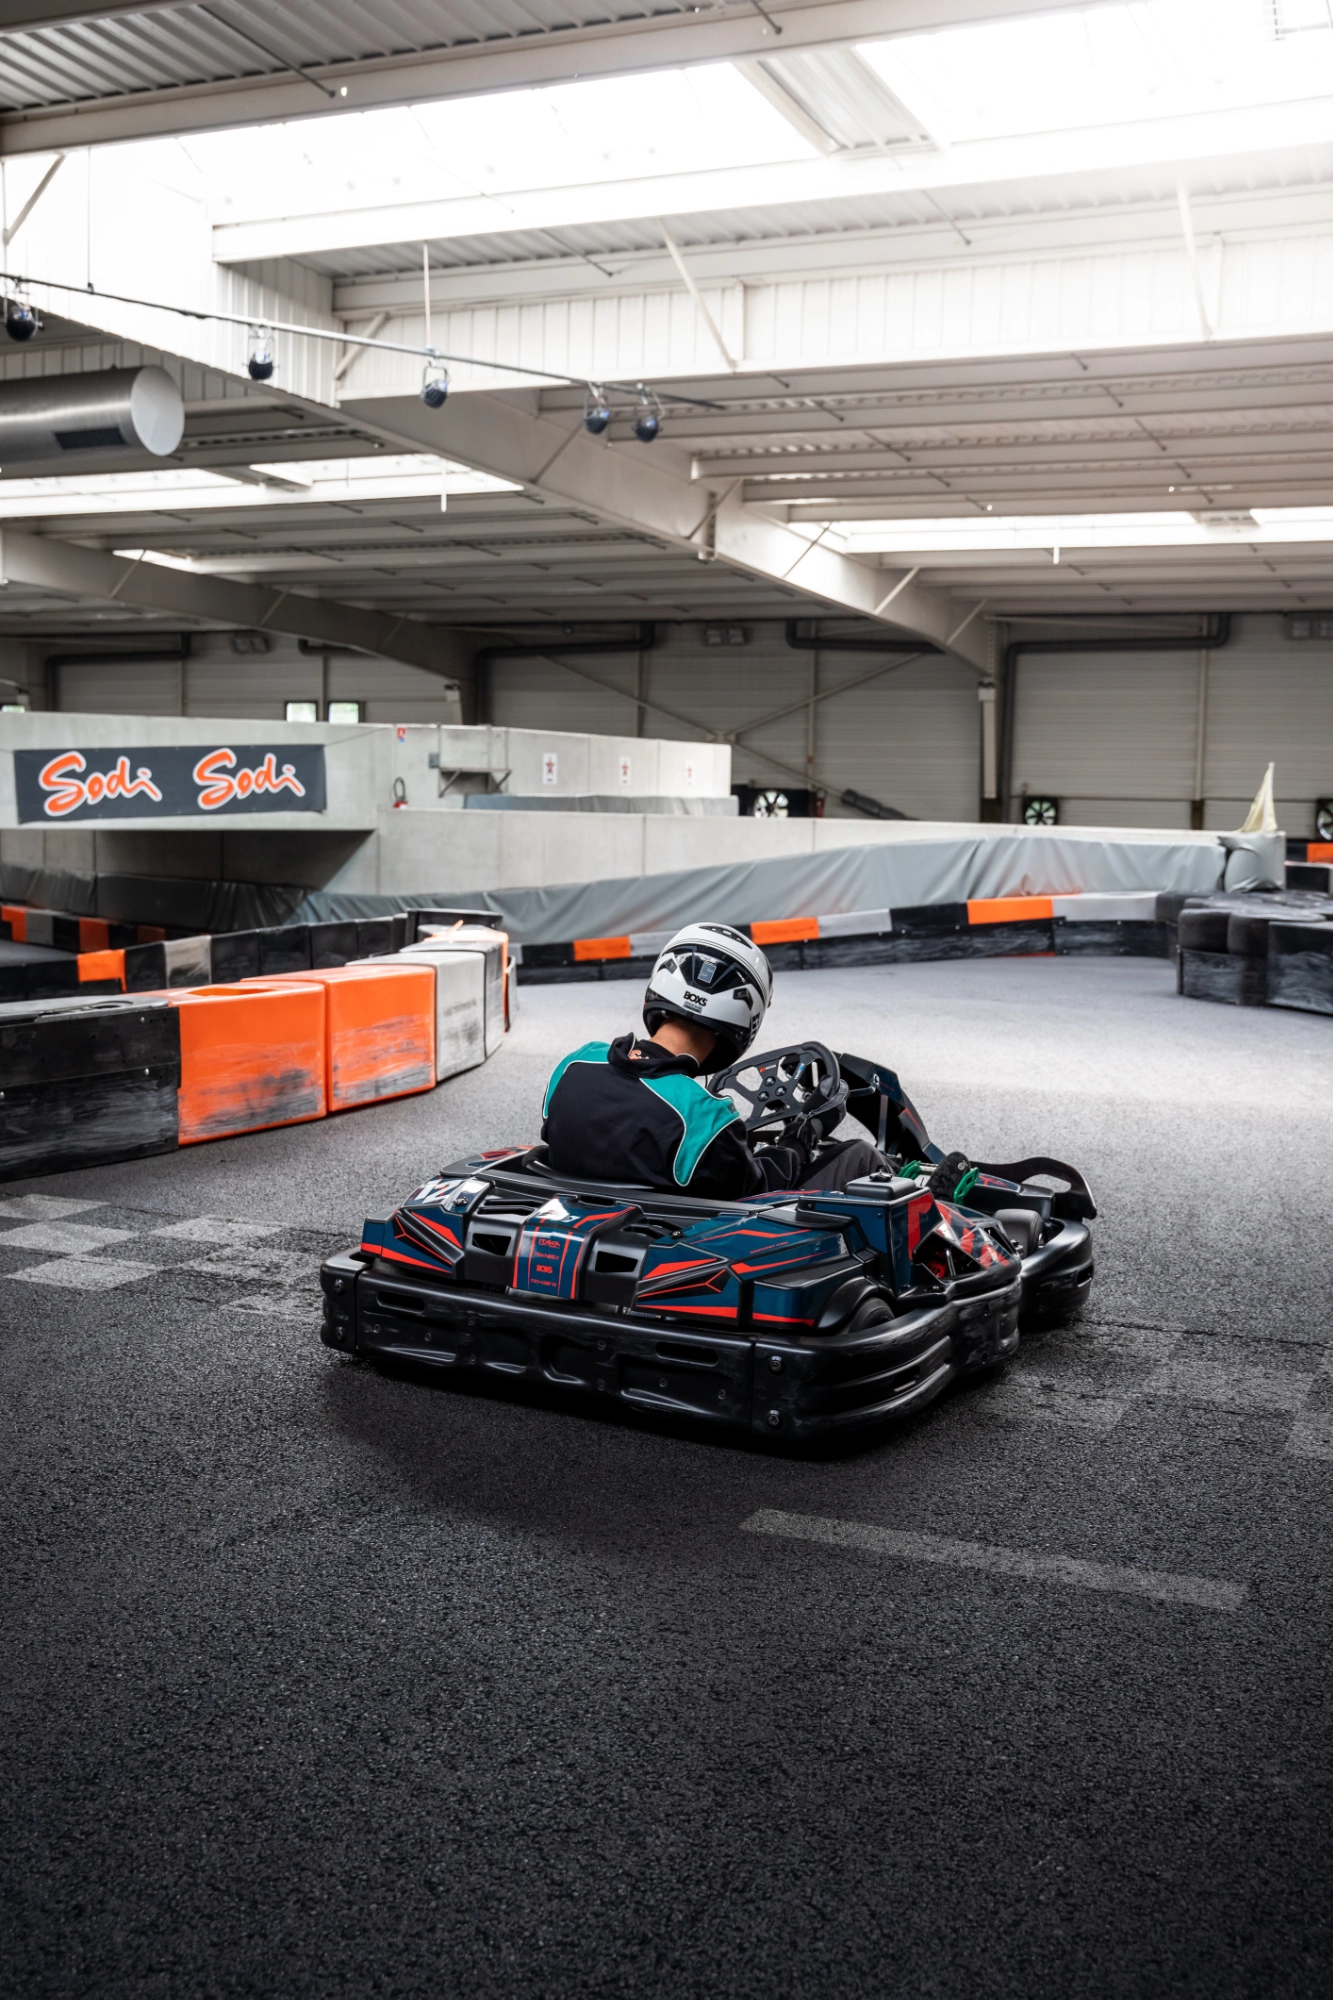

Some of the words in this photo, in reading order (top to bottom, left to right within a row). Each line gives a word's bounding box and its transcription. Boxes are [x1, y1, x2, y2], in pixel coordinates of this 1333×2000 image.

[39, 751, 162, 816] Sodi
[192, 748, 305, 810] Sodi
[683, 990, 708, 1007] BOXS
